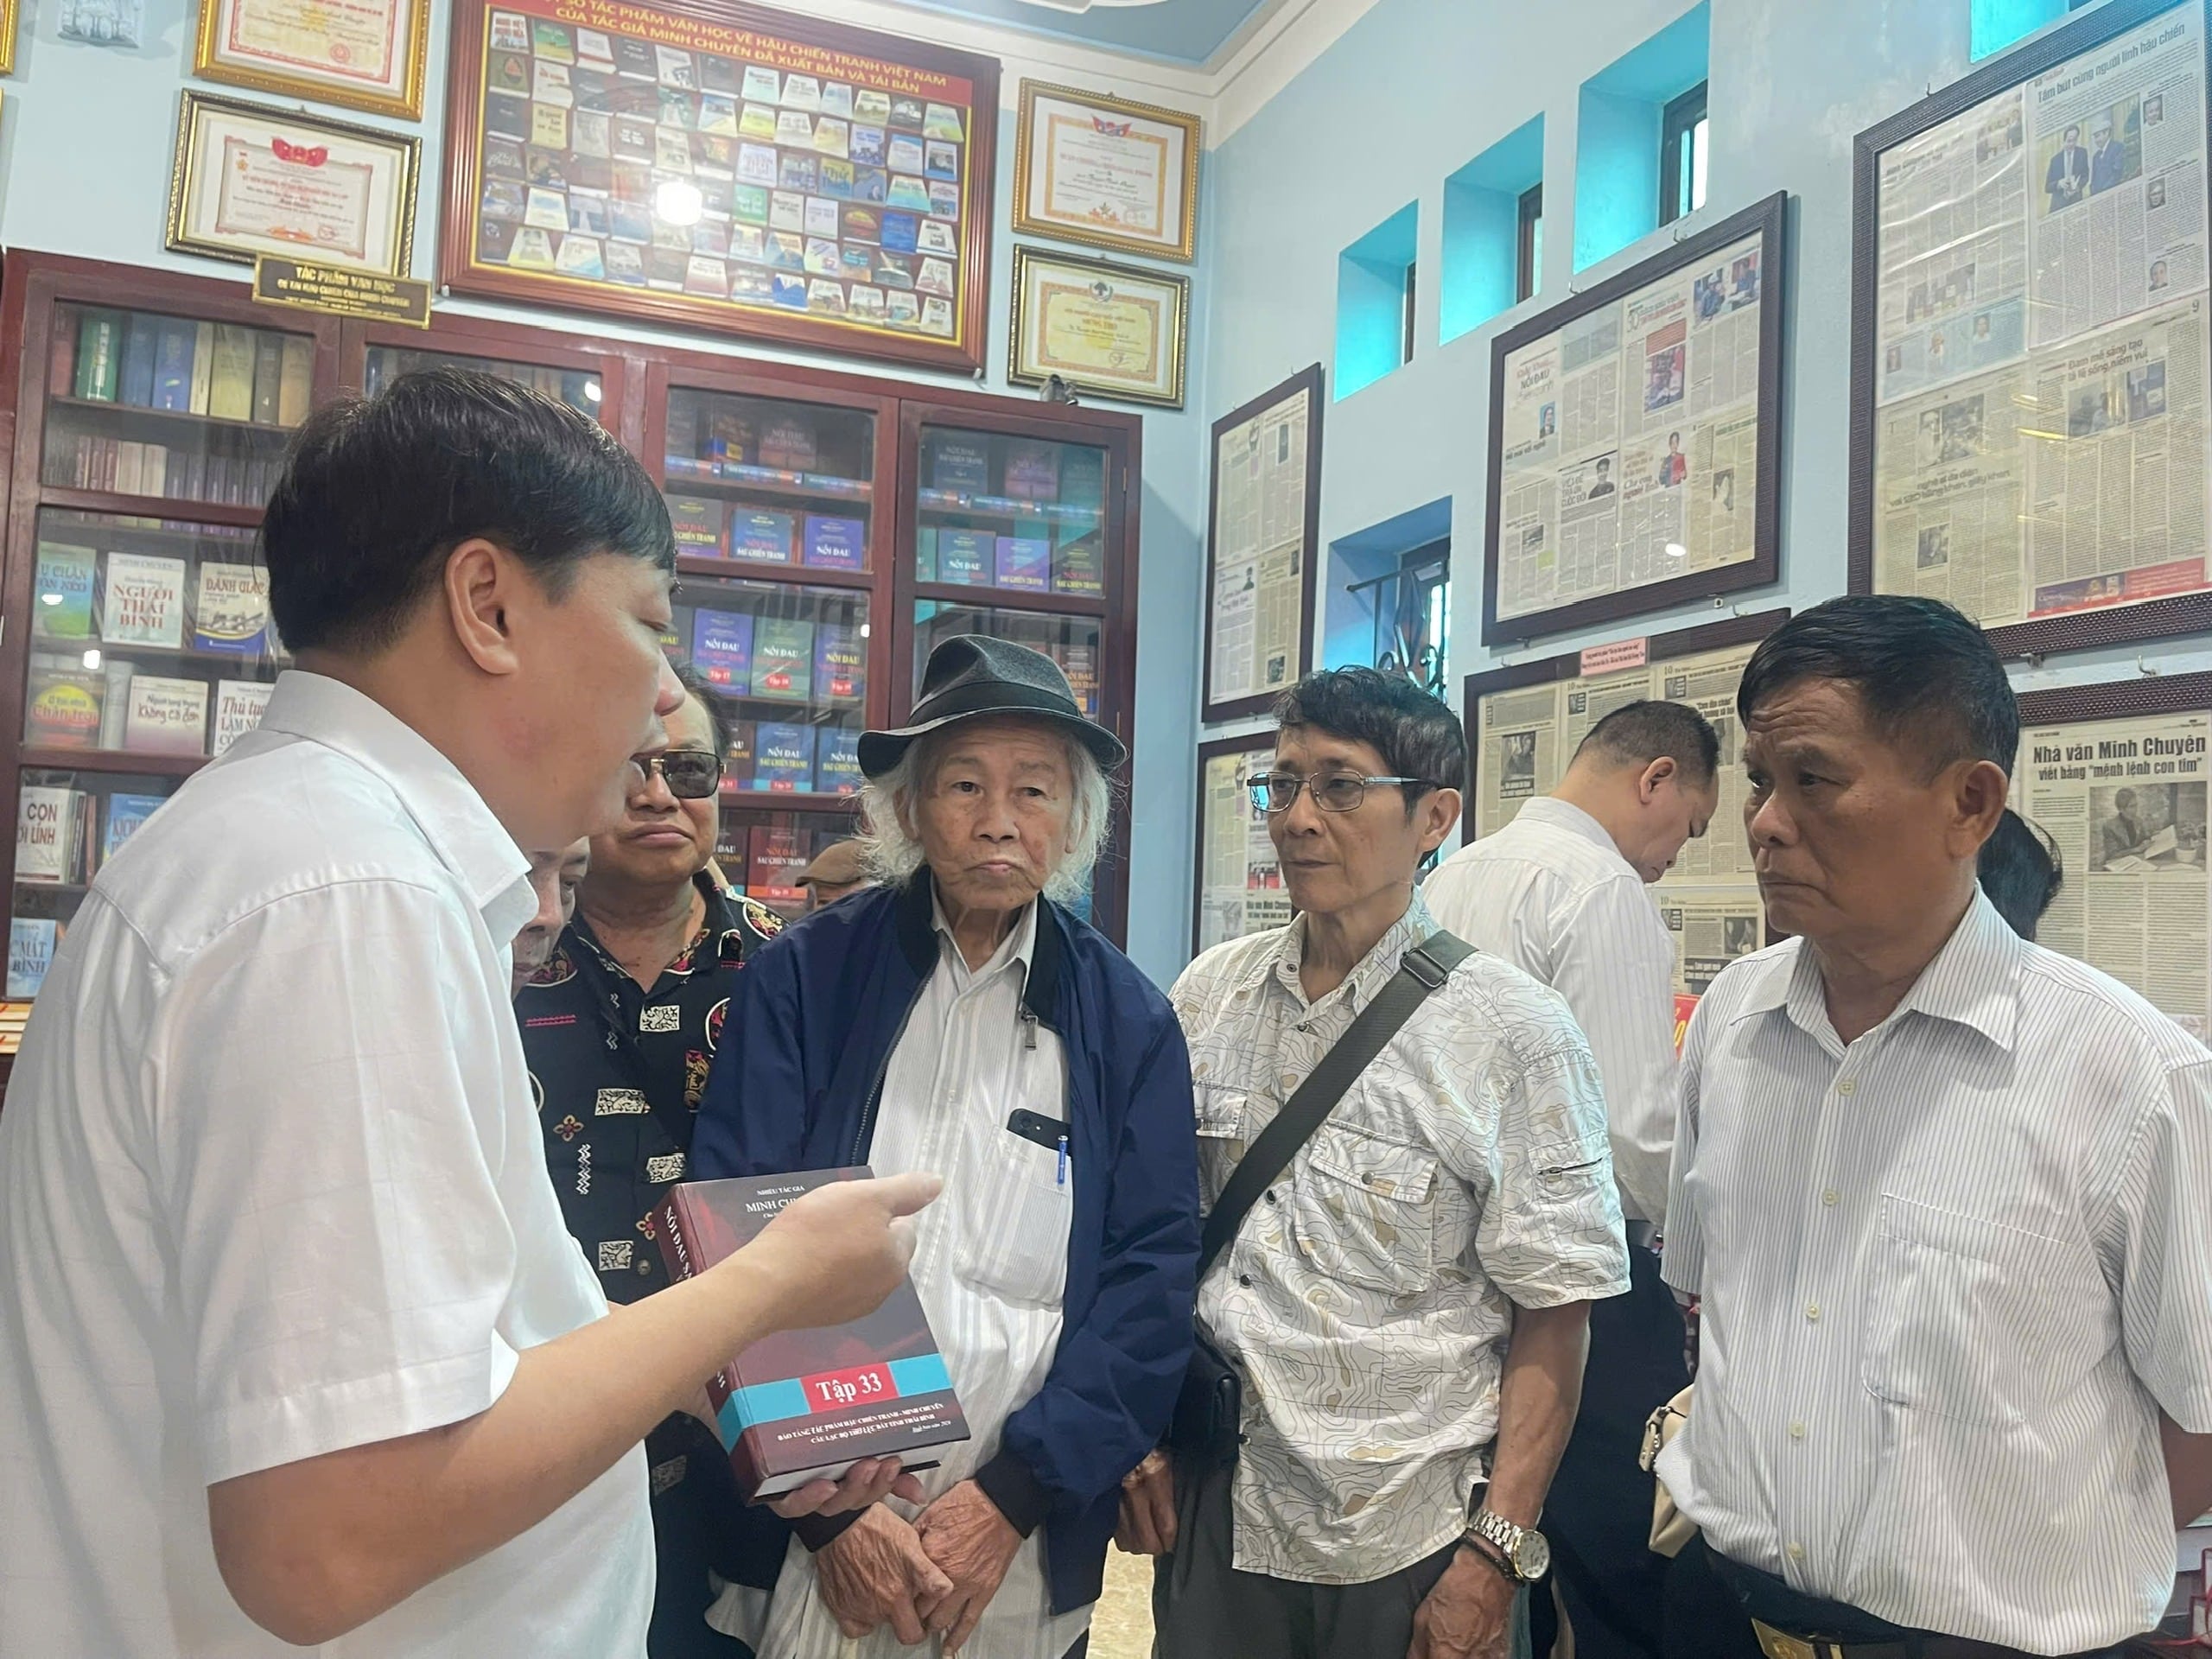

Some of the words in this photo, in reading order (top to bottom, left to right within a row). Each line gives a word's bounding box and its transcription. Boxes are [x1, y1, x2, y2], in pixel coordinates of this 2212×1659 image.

[556, 7, 587, 23] CỦA
[590, 13, 618, 29] TÁC
[620, 21, 646, 35] GIẢ
[650, 28, 691, 44] MINH
[694, 36, 751, 58] CHUYÊN
[754, 46, 776, 64] ĐÃ
[778, 52, 812, 71] XUẤT
[816, 60, 845, 79] BẢN
[847, 67, 867, 82] VÀ
[868, 72, 889, 86] TÁI
[892, 78, 920, 94] BẢN
[620, 6, 665, 25] PHẨM
[668, 13, 699, 33] VĂN
[702, 22, 733, 40] HỌC
[735, 31, 753, 44] VỀ
[756, 35, 787, 53] HẬU
[790, 44, 831, 61] CHIẾN
[834, 54, 880, 73] TRANH
[882, 62, 912, 79] VIỆT
[913, 71, 947, 87] NAM
[2072, 68, 2094, 87] cùng
[2095, 52, 2121, 77] người
[2121, 46, 2139, 65] lính
[2140, 36, 2158, 55] hậu
[2158, 22, 2185, 46] chiến
[296, 264, 316, 282] TÁC
[2106, 344, 2127, 358] sáng
[2128, 339, 2143, 351] tạo
[704, 639, 721, 651] NỖI
[721, 641, 741, 652] ĐAU
[763, 645, 779, 658] NỖI
[779, 649, 799, 658] ĐAU
[222, 696, 247, 715] Thủ
[767, 746, 784, 758] NỖI
[784, 748, 802, 758] ĐAU
[830, 751, 847, 762] NỖI
[847, 753, 859, 762] ĐA
[2033, 744, 2062, 764] Nhà
[2066, 742, 2094, 761] văn
[2098, 739, 2138, 760] Minh
[2143, 734, 2207, 757] Chuyên
[2038, 765, 2058, 781] viết
[2060, 765, 2087, 781] bằng
[2126, 760, 2151, 779] lệnh
[2154, 760, 2176, 775] con
[27, 803, 59, 822] CON
[30, 822, 56, 845] LÍNH
[778, 1185, 792, 1194] TÁC
[745, 1198, 778, 1213] MINH
[815, 1378, 857, 1404] Tập
[858, 1371, 884, 1395] 33
